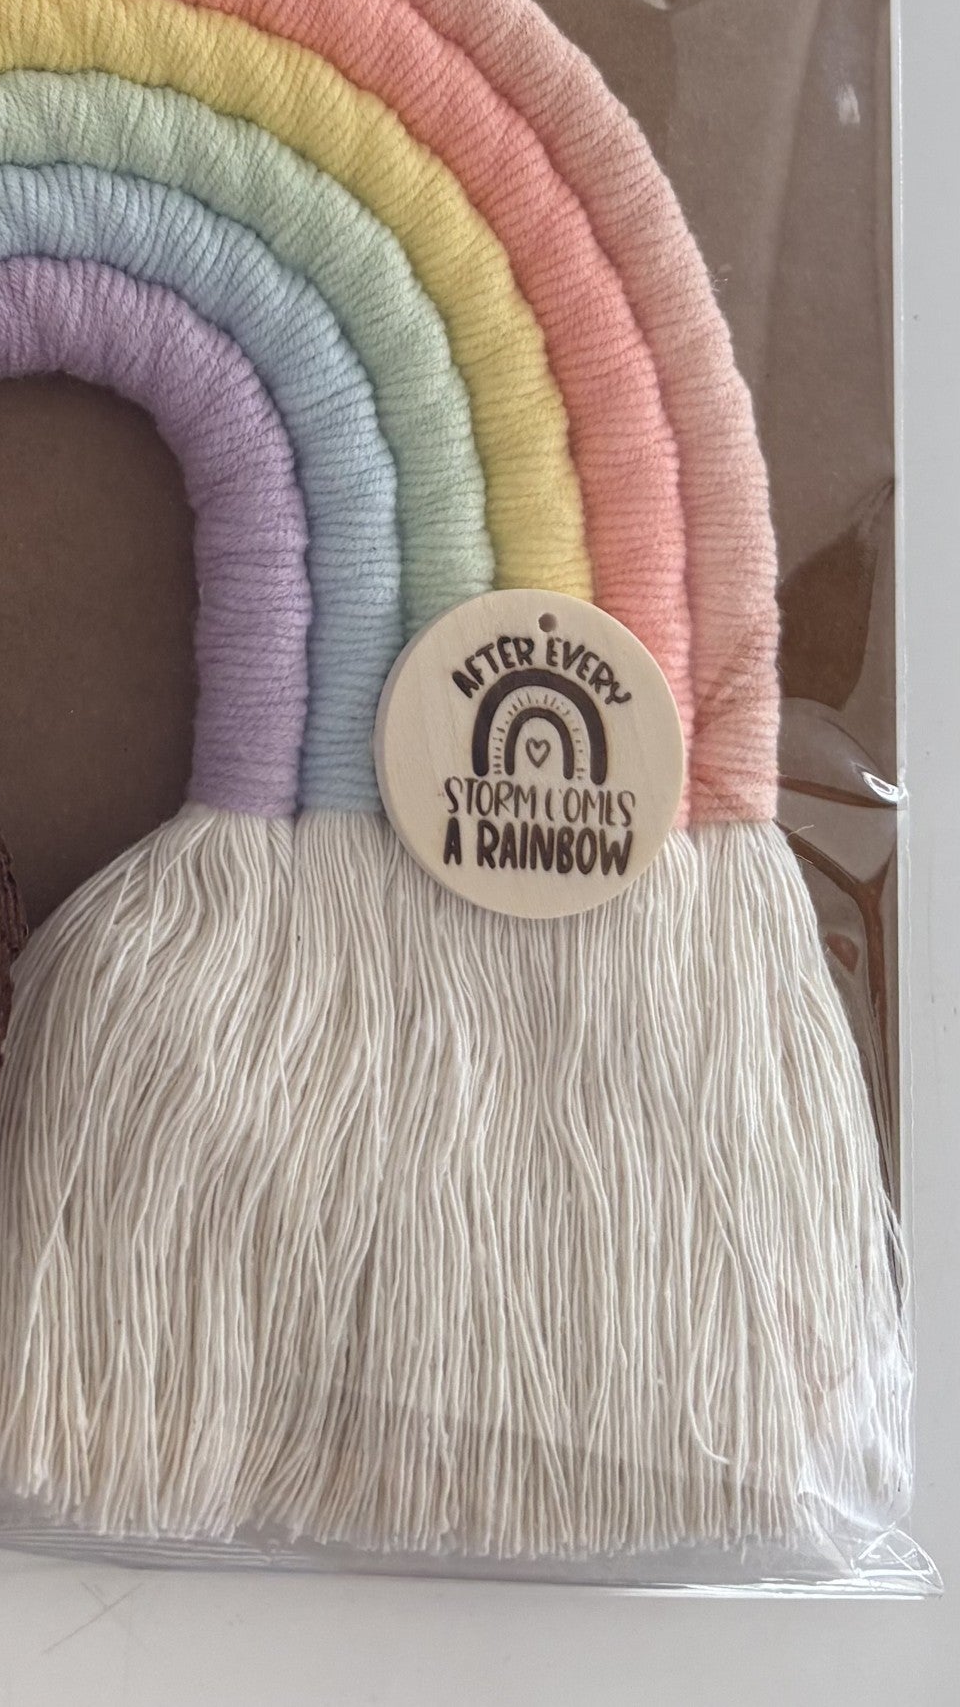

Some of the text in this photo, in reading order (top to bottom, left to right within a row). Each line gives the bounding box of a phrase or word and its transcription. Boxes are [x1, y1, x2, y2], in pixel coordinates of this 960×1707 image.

[452, 635, 632, 705] AFTER EVERY
[444, 776, 635, 827] STORM COMES
[442, 816, 633, 876] A RAINBOW
